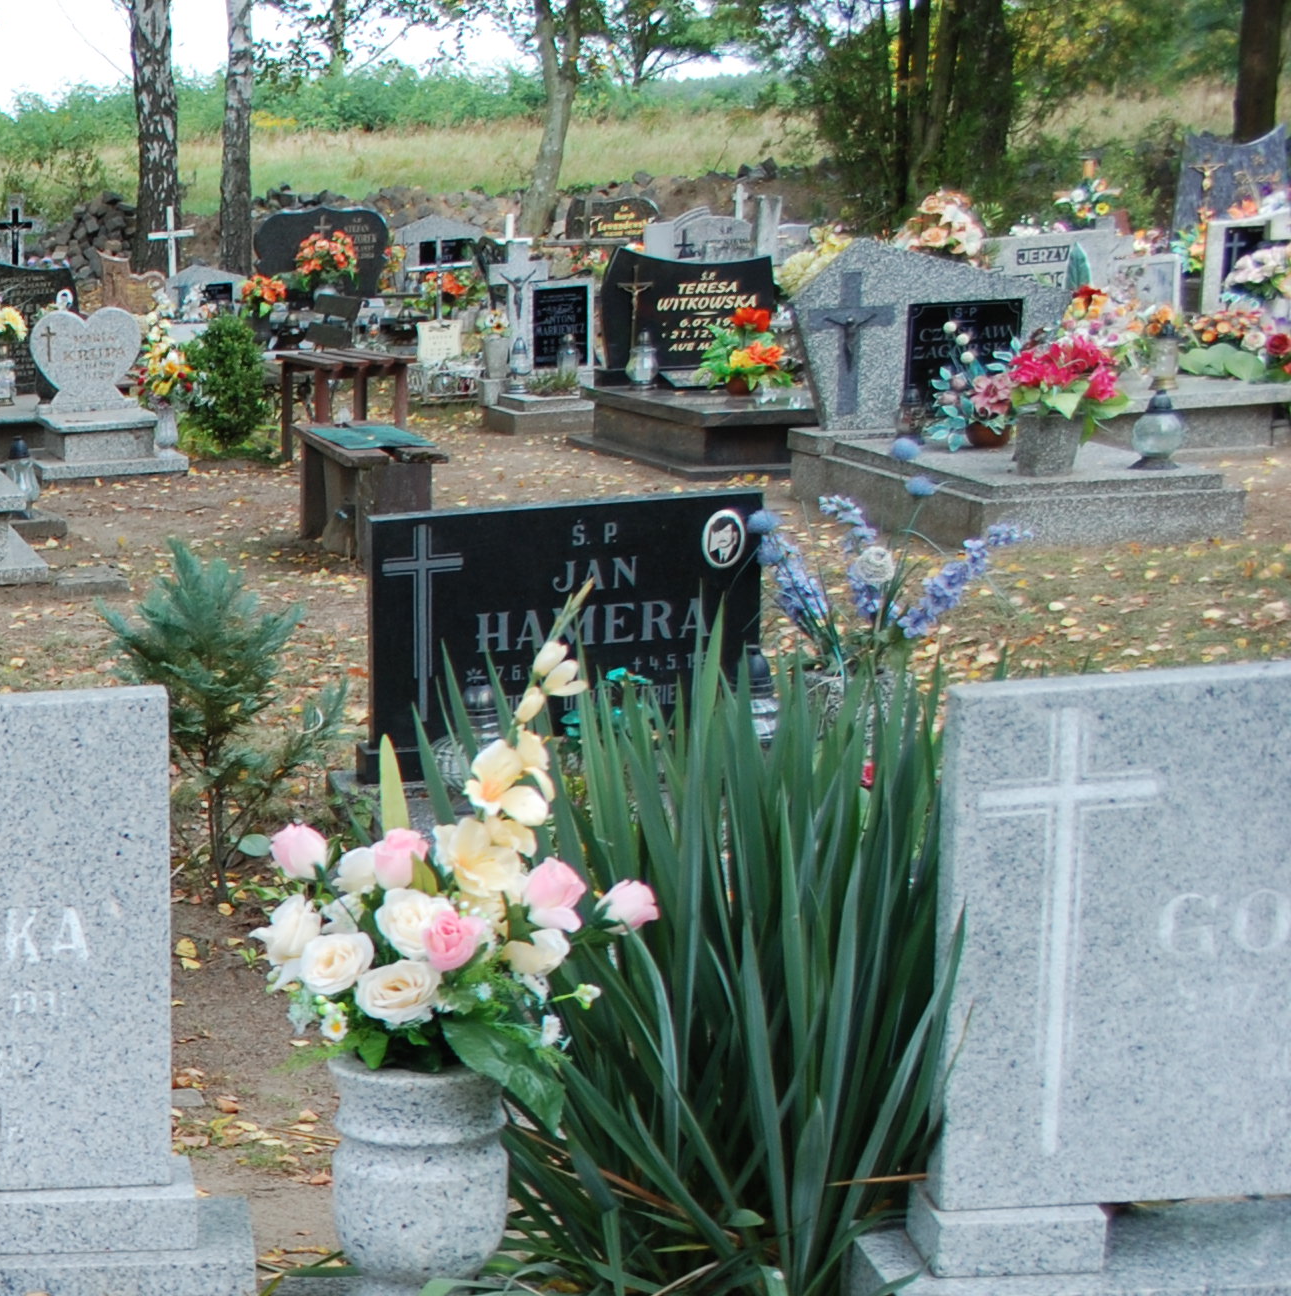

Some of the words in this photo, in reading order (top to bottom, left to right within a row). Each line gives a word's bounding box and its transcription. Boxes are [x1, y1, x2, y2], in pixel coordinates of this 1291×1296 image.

[1018, 248, 1068, 264] JERZY
[678, 281, 739, 296] TERESA
[657, 294, 758, 313] WITKOWSKA
[552, 555, 638, 593] JAN
[476, 597, 712, 653] HAMERA
